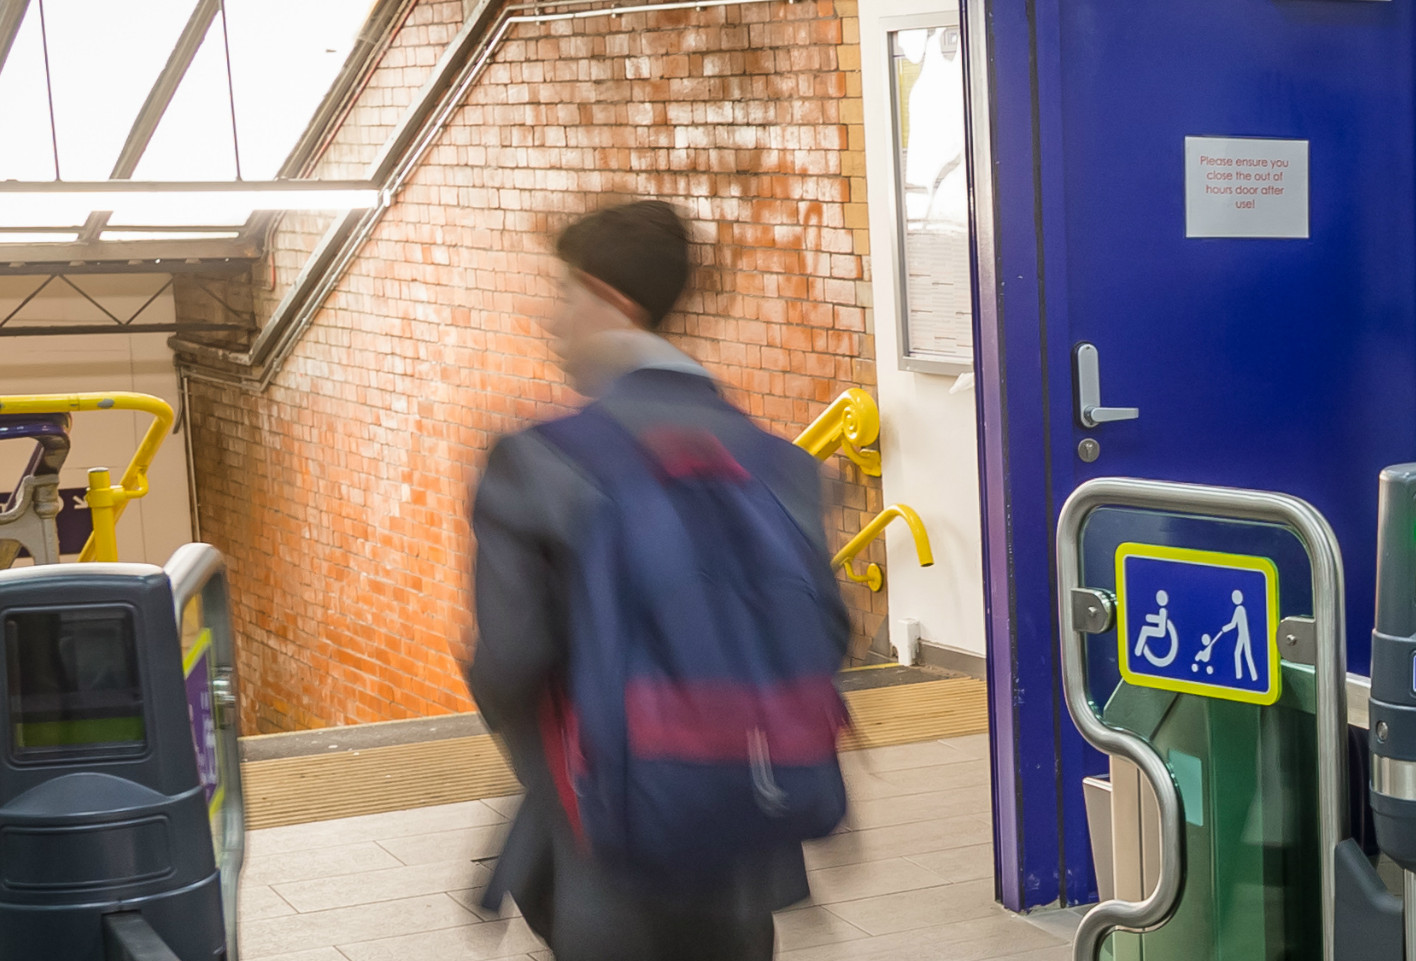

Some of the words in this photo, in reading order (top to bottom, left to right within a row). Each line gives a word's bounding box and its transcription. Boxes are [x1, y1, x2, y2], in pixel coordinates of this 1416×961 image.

[1200, 156, 1233, 166] Please
[1235, 158, 1268, 167] ensure
[1271, 160, 1289, 169] you
[1206, 170, 1233, 181] close
[1235, 171, 1251, 181] the
[1254, 172, 1271, 181] out
[1273, 172, 1283, 181] of
[1205, 185, 1233, 194] hours
[1235, 185, 1259, 195] door
[1260, 186, 1284, 195] after
[1235, 199, 1255, 209] use!
